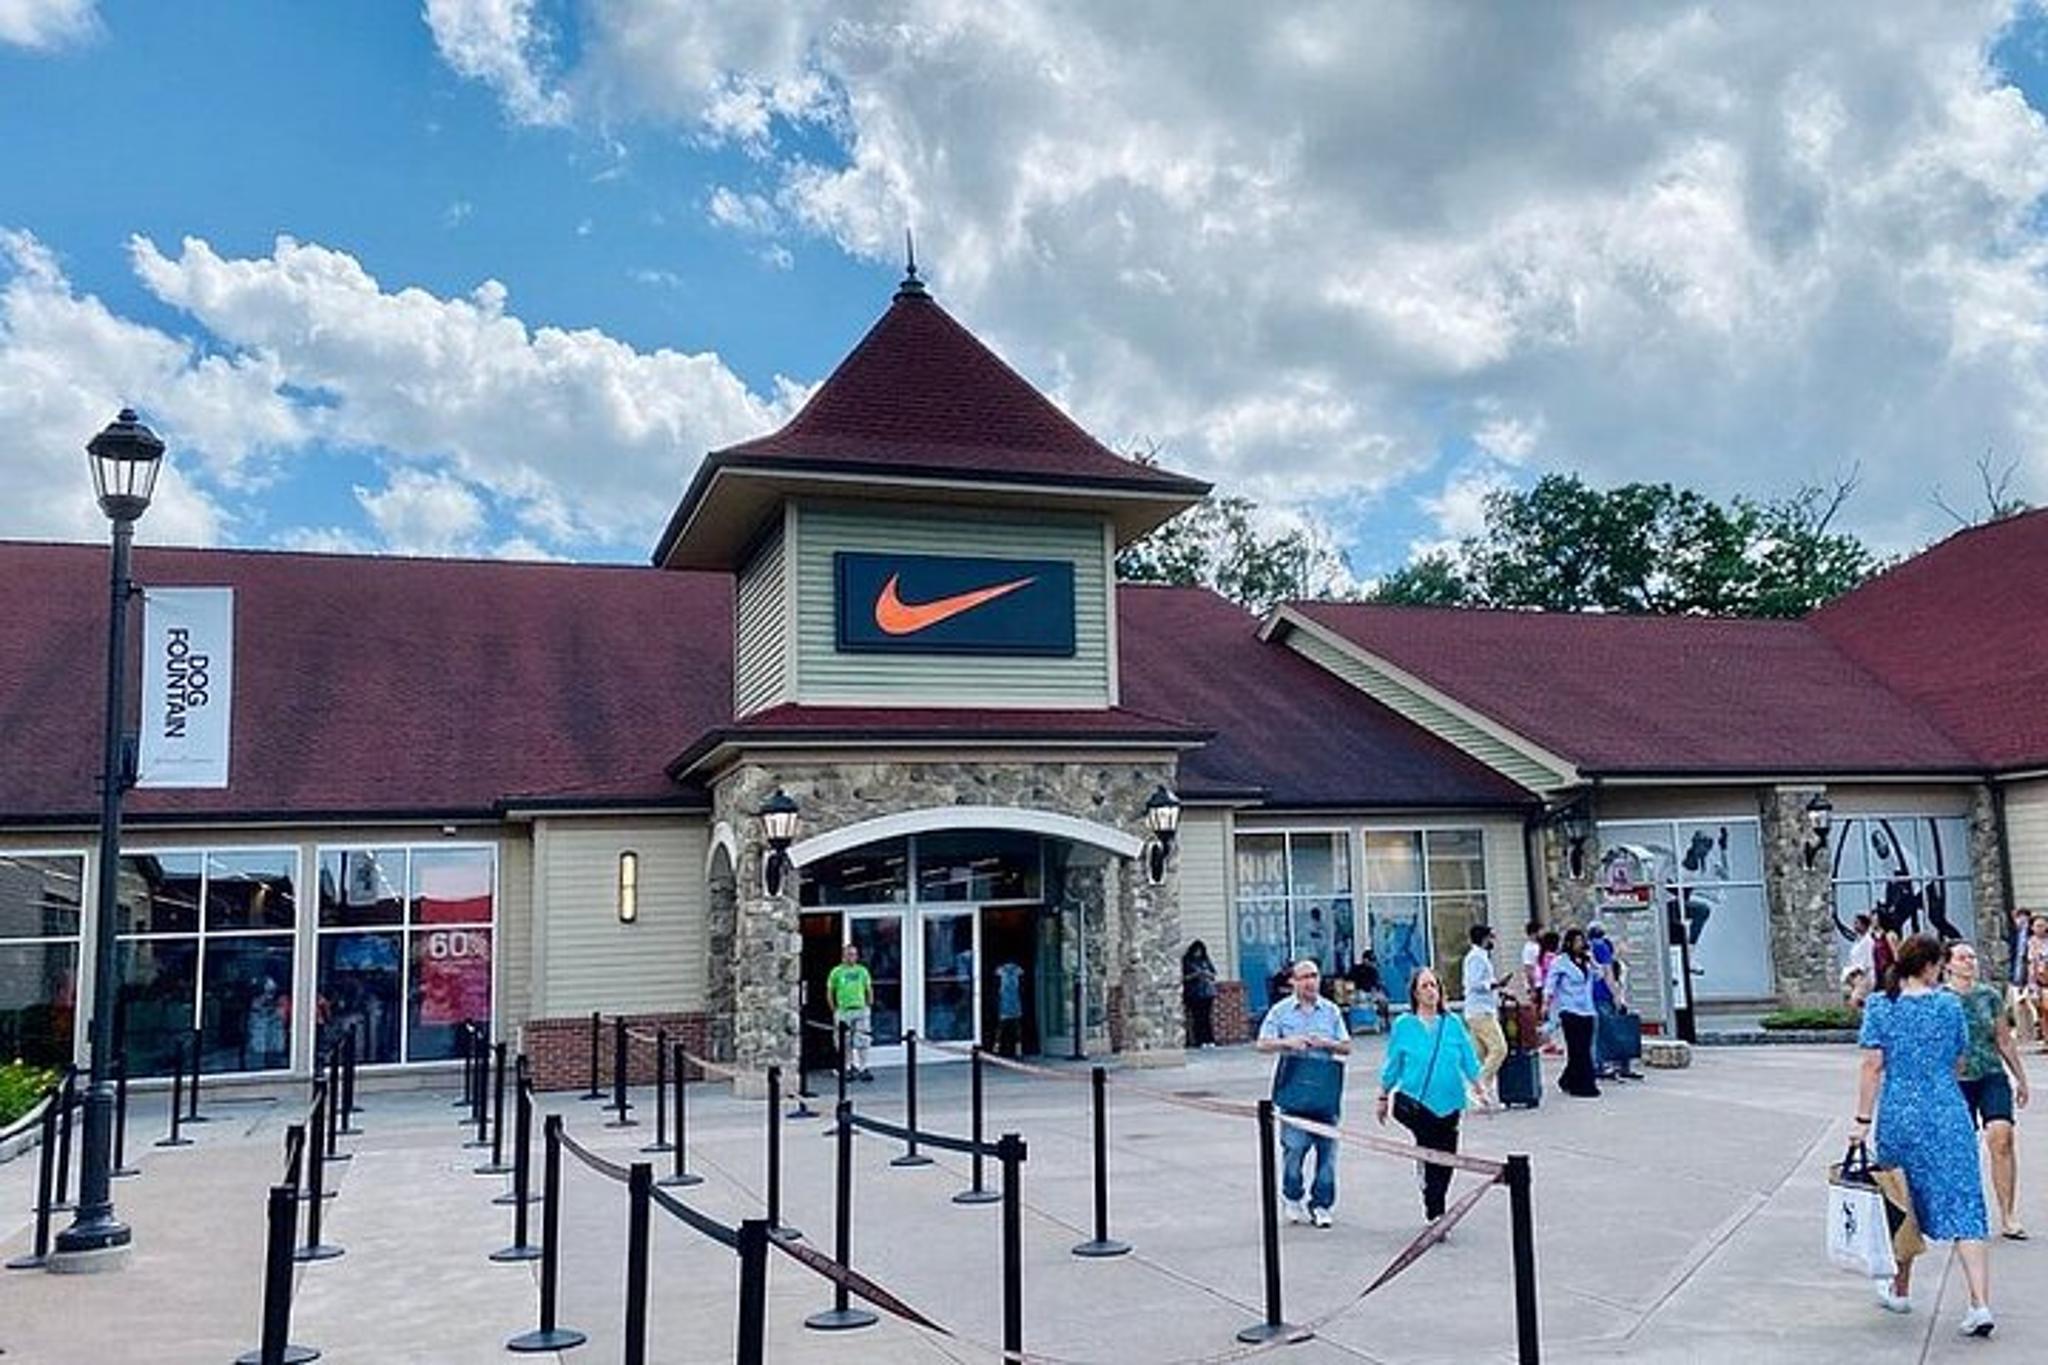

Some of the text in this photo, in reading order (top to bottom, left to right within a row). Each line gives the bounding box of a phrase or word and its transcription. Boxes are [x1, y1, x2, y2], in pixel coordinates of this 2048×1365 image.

[164, 628, 190, 738] FOUNTAIN
[187, 655, 209, 707] DOG
[1239, 855, 1284, 882] NIK
